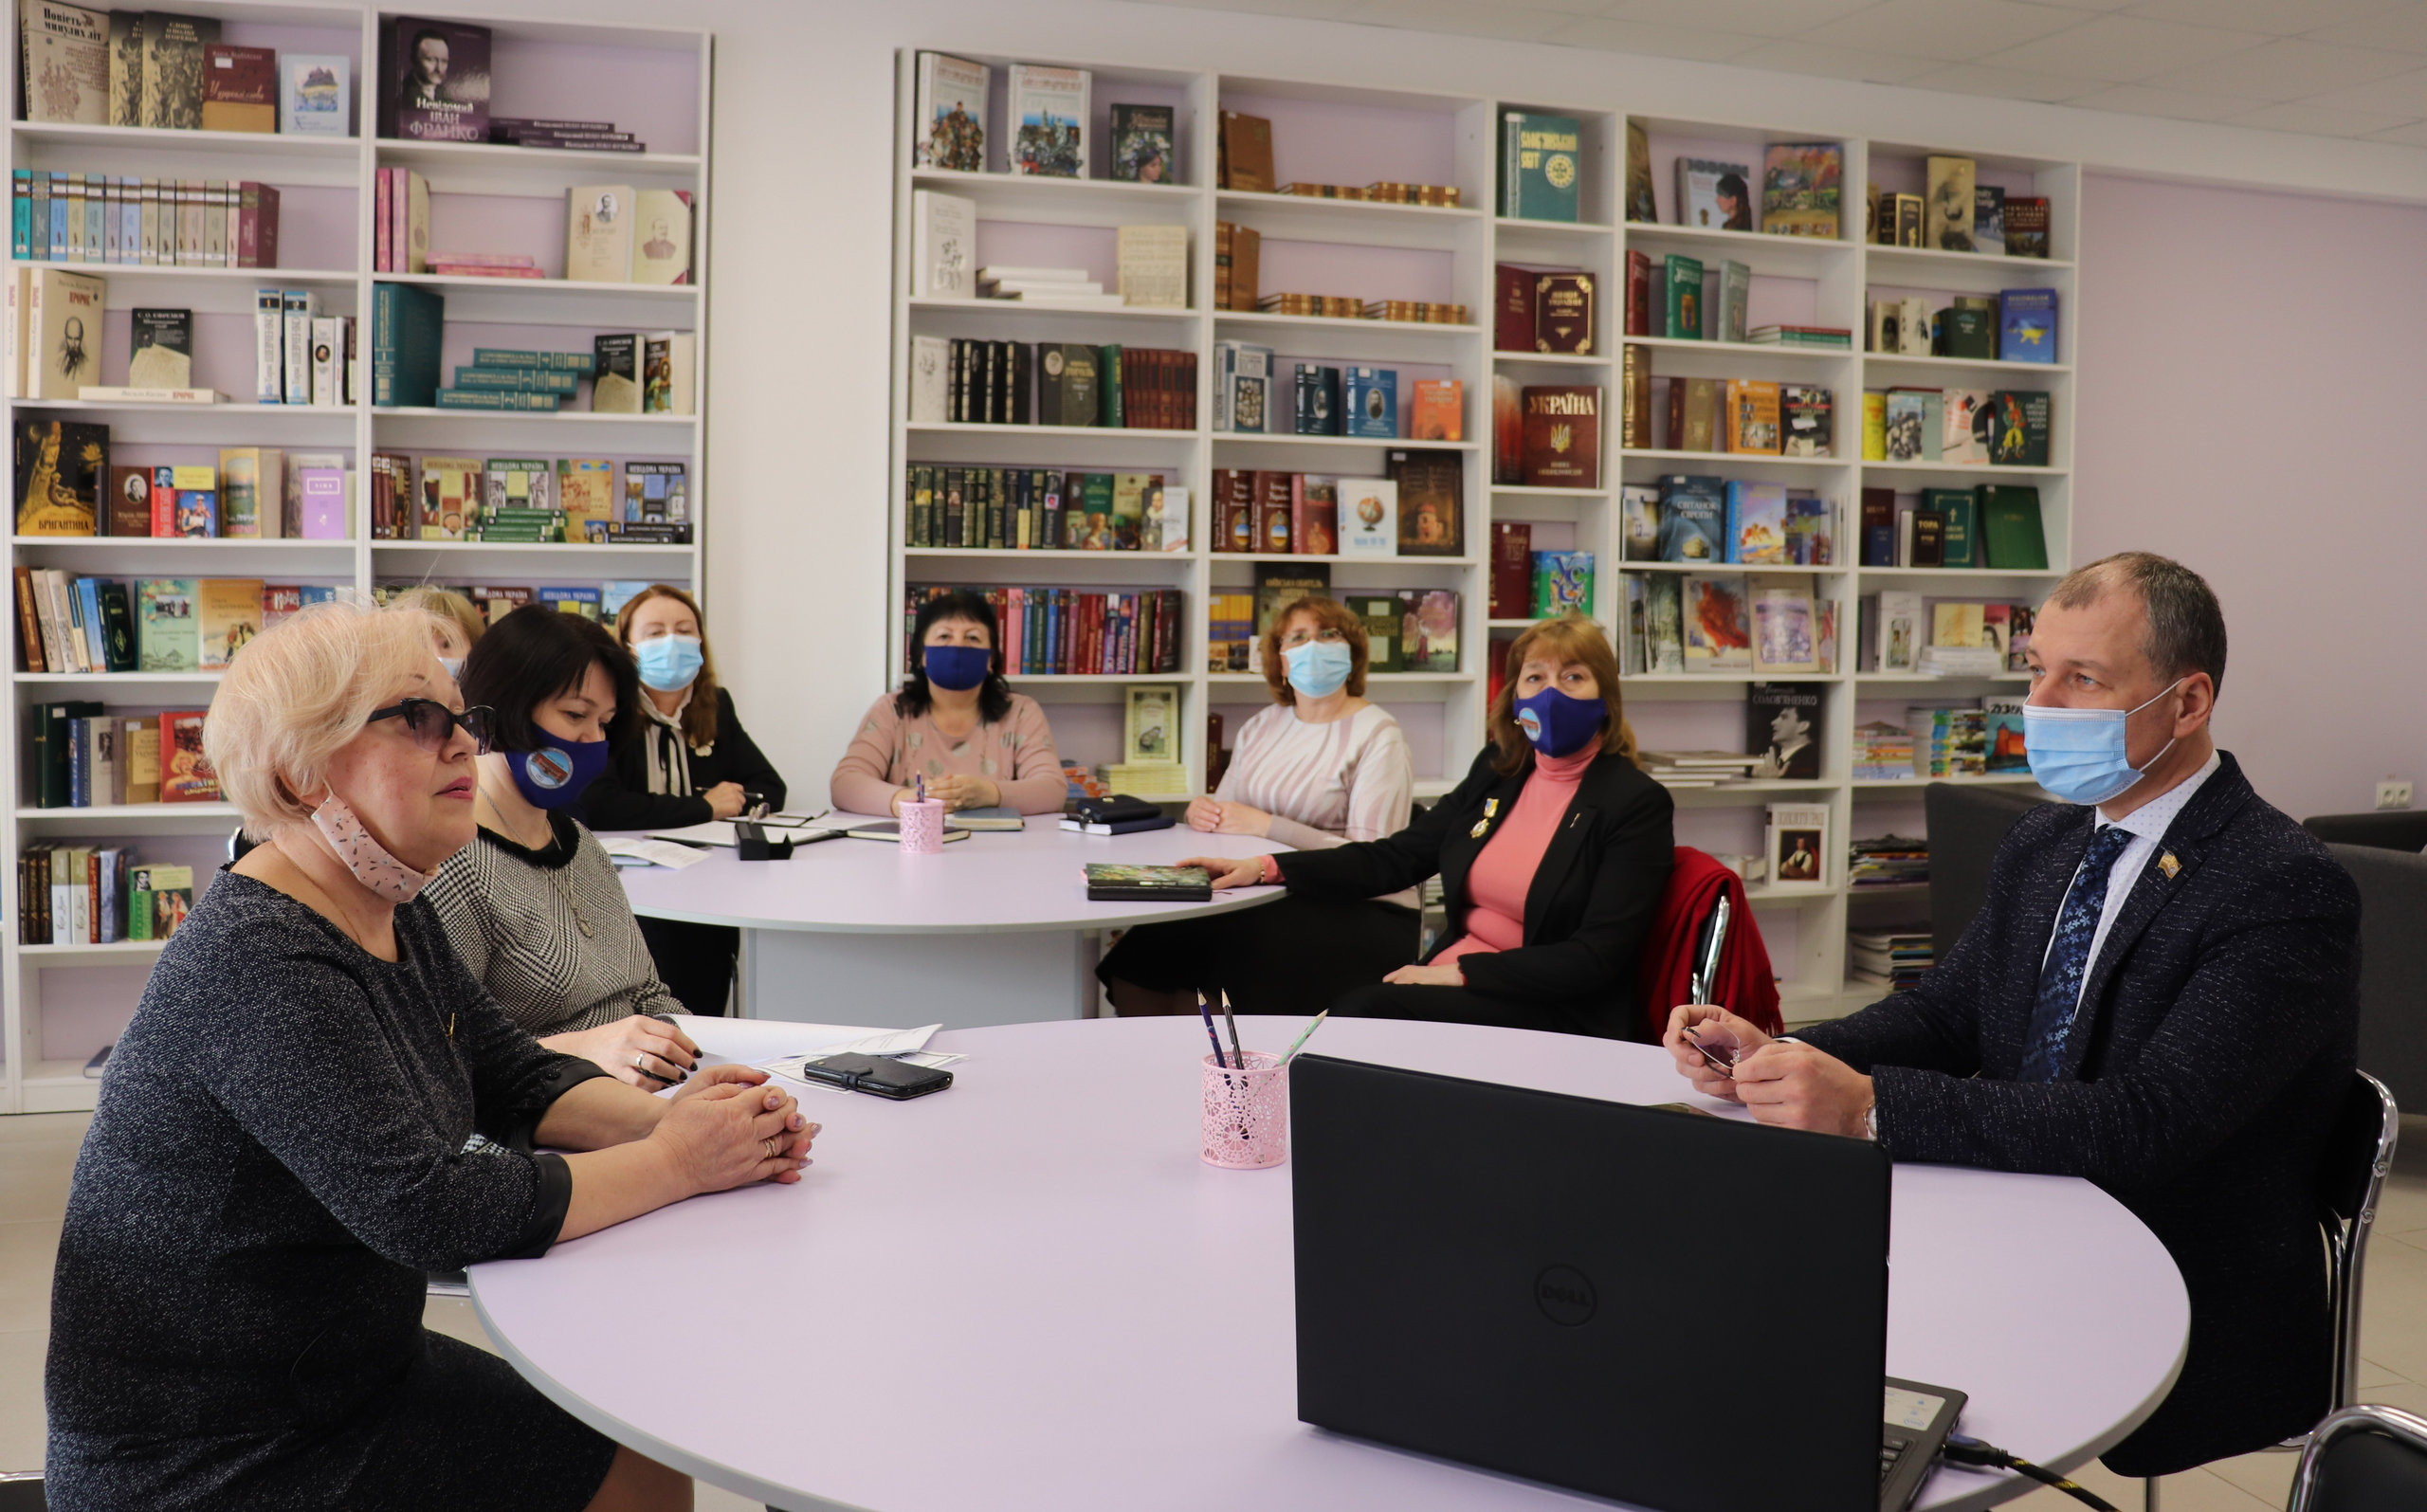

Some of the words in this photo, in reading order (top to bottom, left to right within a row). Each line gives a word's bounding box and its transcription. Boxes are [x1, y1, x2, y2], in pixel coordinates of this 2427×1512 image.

[44, 8, 82, 27] Повість
[416, 97, 474, 112] Невідомий
[430, 111, 460, 124] ІВАН
[410, 121, 479, 141] ФРАНКО
[1529, 392, 1595, 415] УКРАЇНА
[522, 462, 545, 470] УКРАЇНА
[629, 464, 657, 473] НЕВІДОМА
[659, 465, 681, 474] УКРАЇНА
[1677, 501, 1716, 511] СВІТАНОК
[38, 519, 89, 531] БРИГАНТИНА
[504, 591, 528, 599] УКРАЇНА
[574, 592, 595, 600] УКРАЇНА
